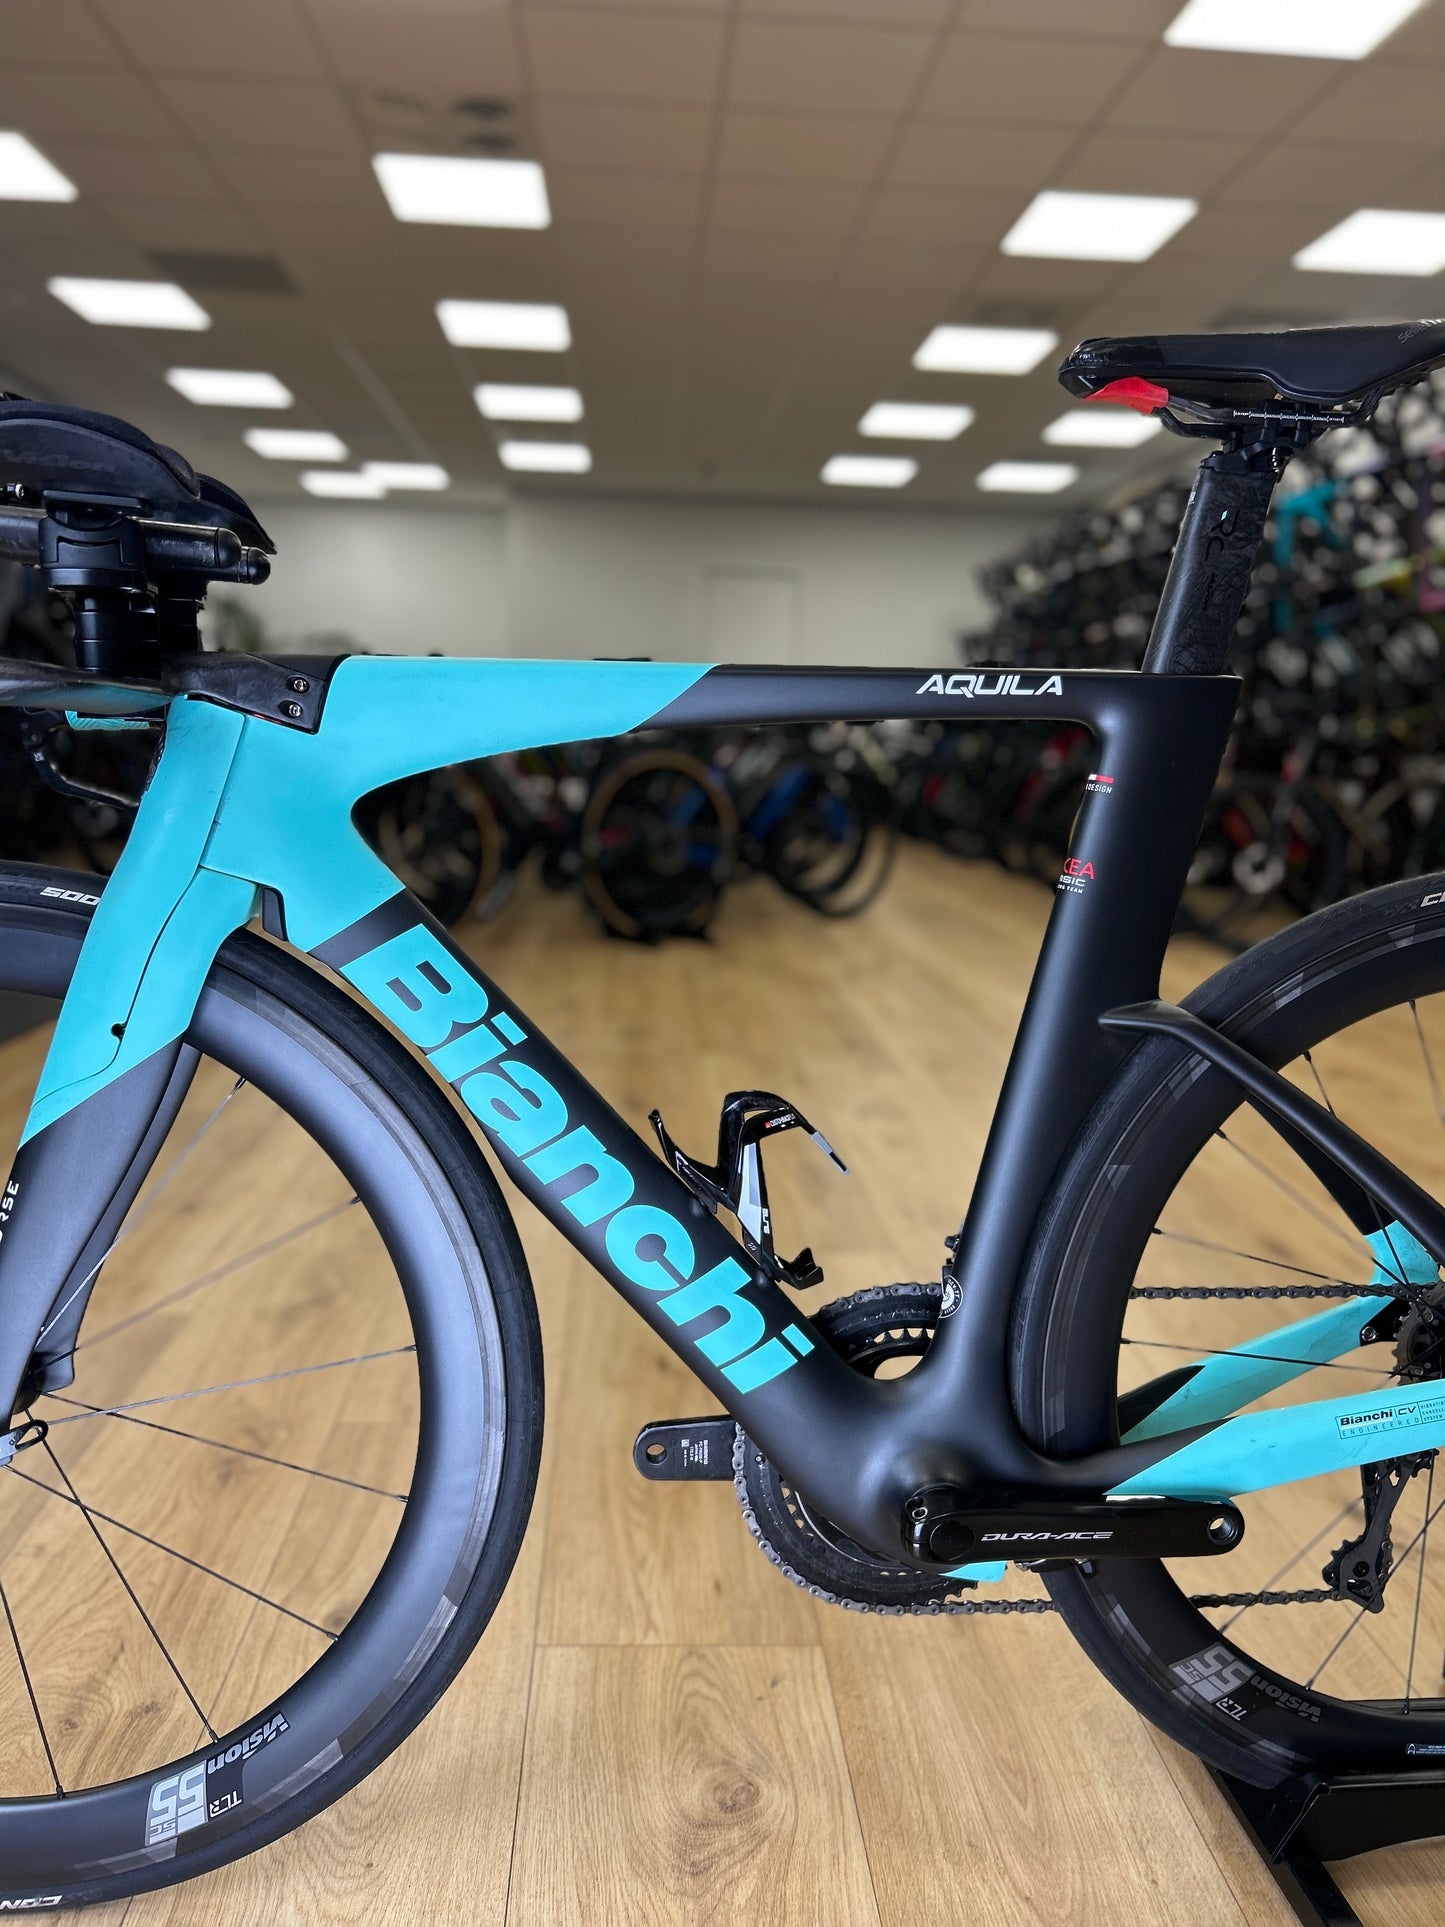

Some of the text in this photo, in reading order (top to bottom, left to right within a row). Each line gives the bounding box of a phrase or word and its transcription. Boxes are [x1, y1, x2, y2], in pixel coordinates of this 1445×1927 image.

[915, 674, 1063, 699] AQUILA
[40, 886, 102, 906] 500
[339, 922, 815, 1395] Bianchi
[1340, 1405, 1416, 1427] Bianchi CV
[1342, 1417, 1420, 1437] ENGINEERED
[981, 1531, 1114, 1542] DURA-ACE
[1189, 1645, 1254, 1695] 55
[1215, 1697, 1248, 1721] TLR
[1250, 1674, 1323, 1724] Vision
[207, 1712, 290, 1775] Vision
[150, 1763, 205, 1828] 55
[209, 1790, 242, 1818] TLR
[150, 1820, 176, 1837] SC
